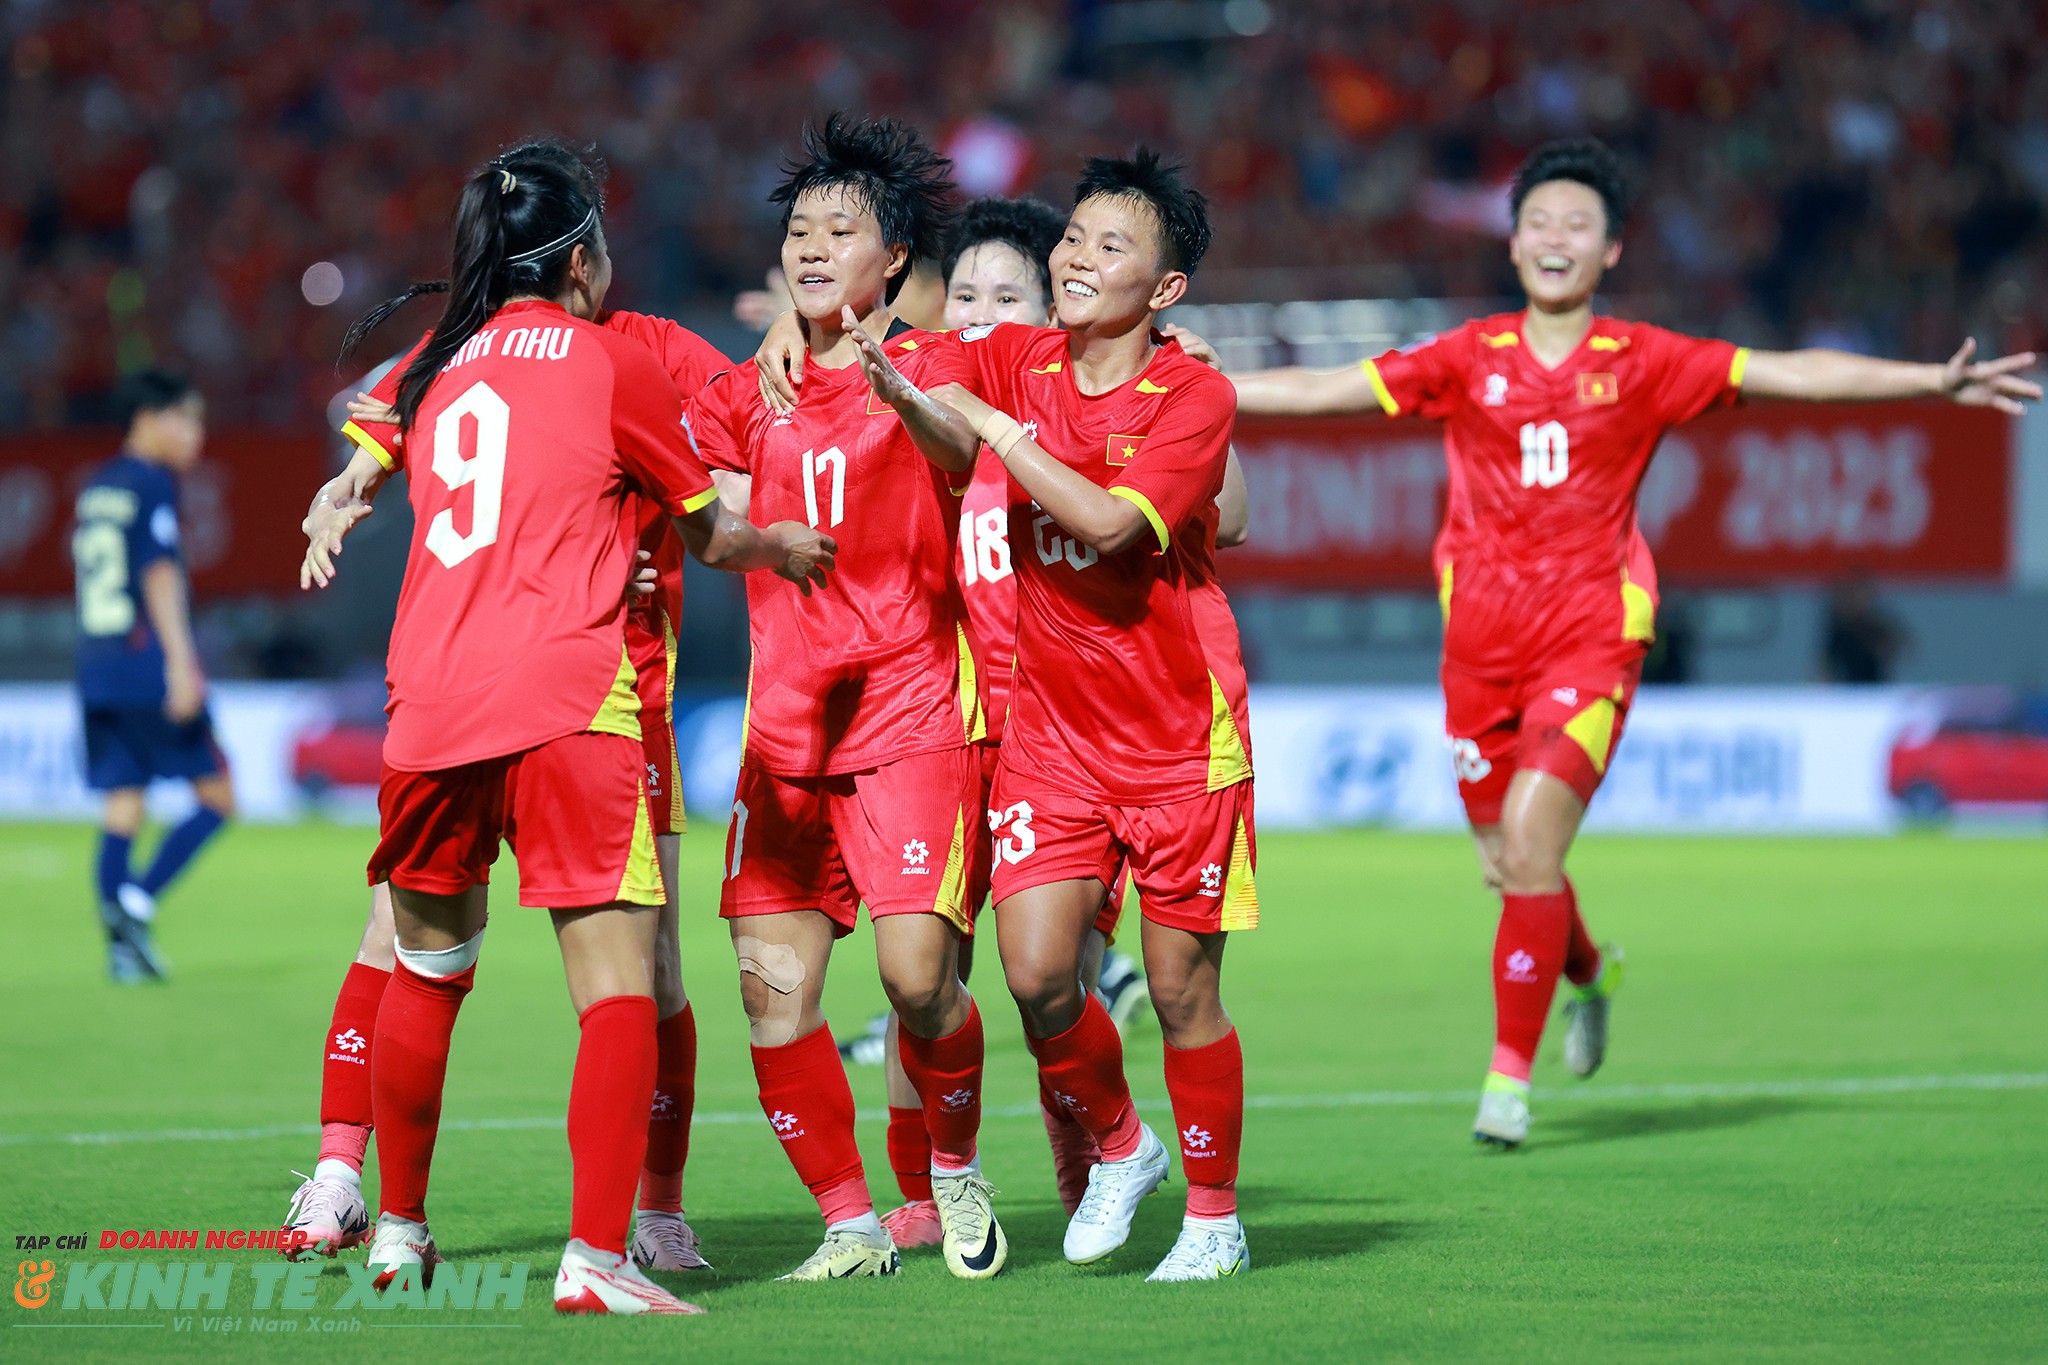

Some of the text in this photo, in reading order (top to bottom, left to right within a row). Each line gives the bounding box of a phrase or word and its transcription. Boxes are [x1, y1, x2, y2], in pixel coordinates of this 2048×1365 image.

[425, 380, 510, 569] 9
[802, 445, 847, 529] 17
[1519, 420, 1569, 489] 10
[960, 506, 1014, 587] 18
